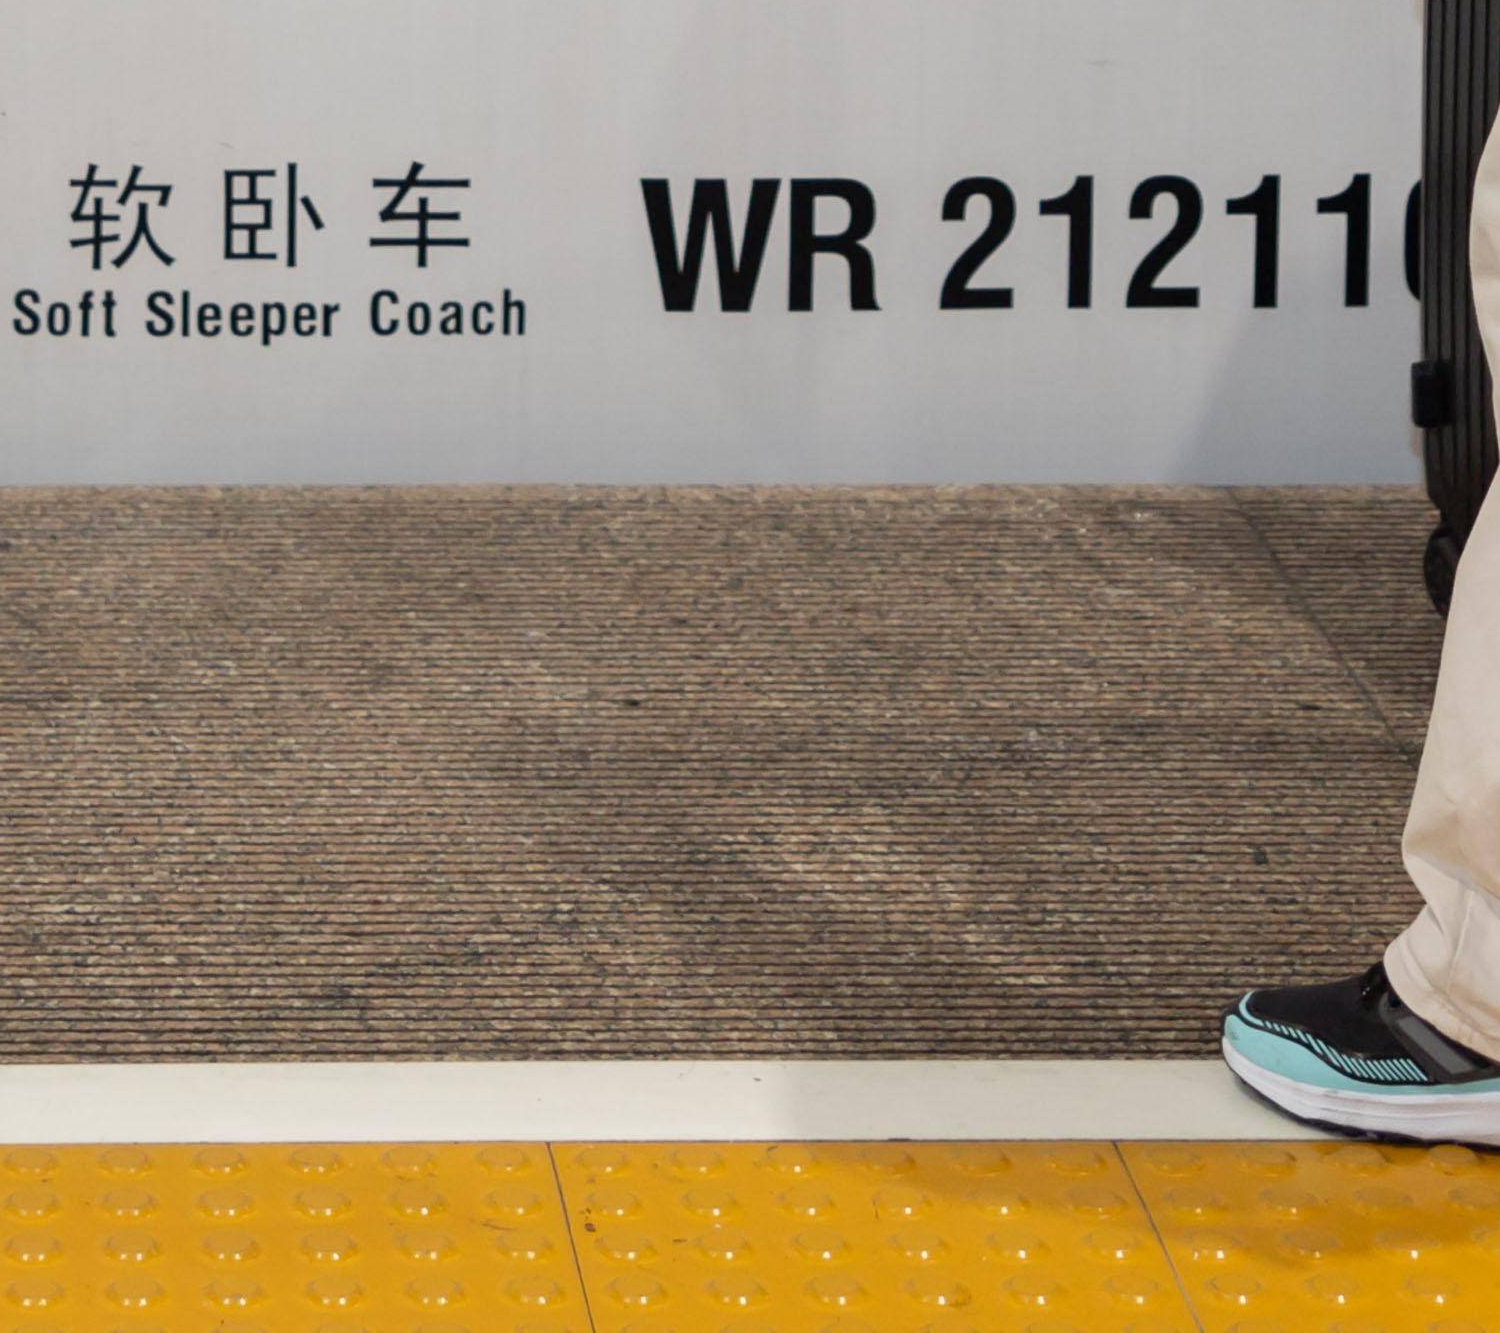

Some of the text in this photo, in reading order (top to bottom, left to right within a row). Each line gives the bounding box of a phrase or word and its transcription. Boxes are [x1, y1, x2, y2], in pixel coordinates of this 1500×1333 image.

[69, 162, 471, 271] 软卧车
[641, 177, 882, 313] WR
[13, 288, 526, 347] Soft Sleeper Coach
